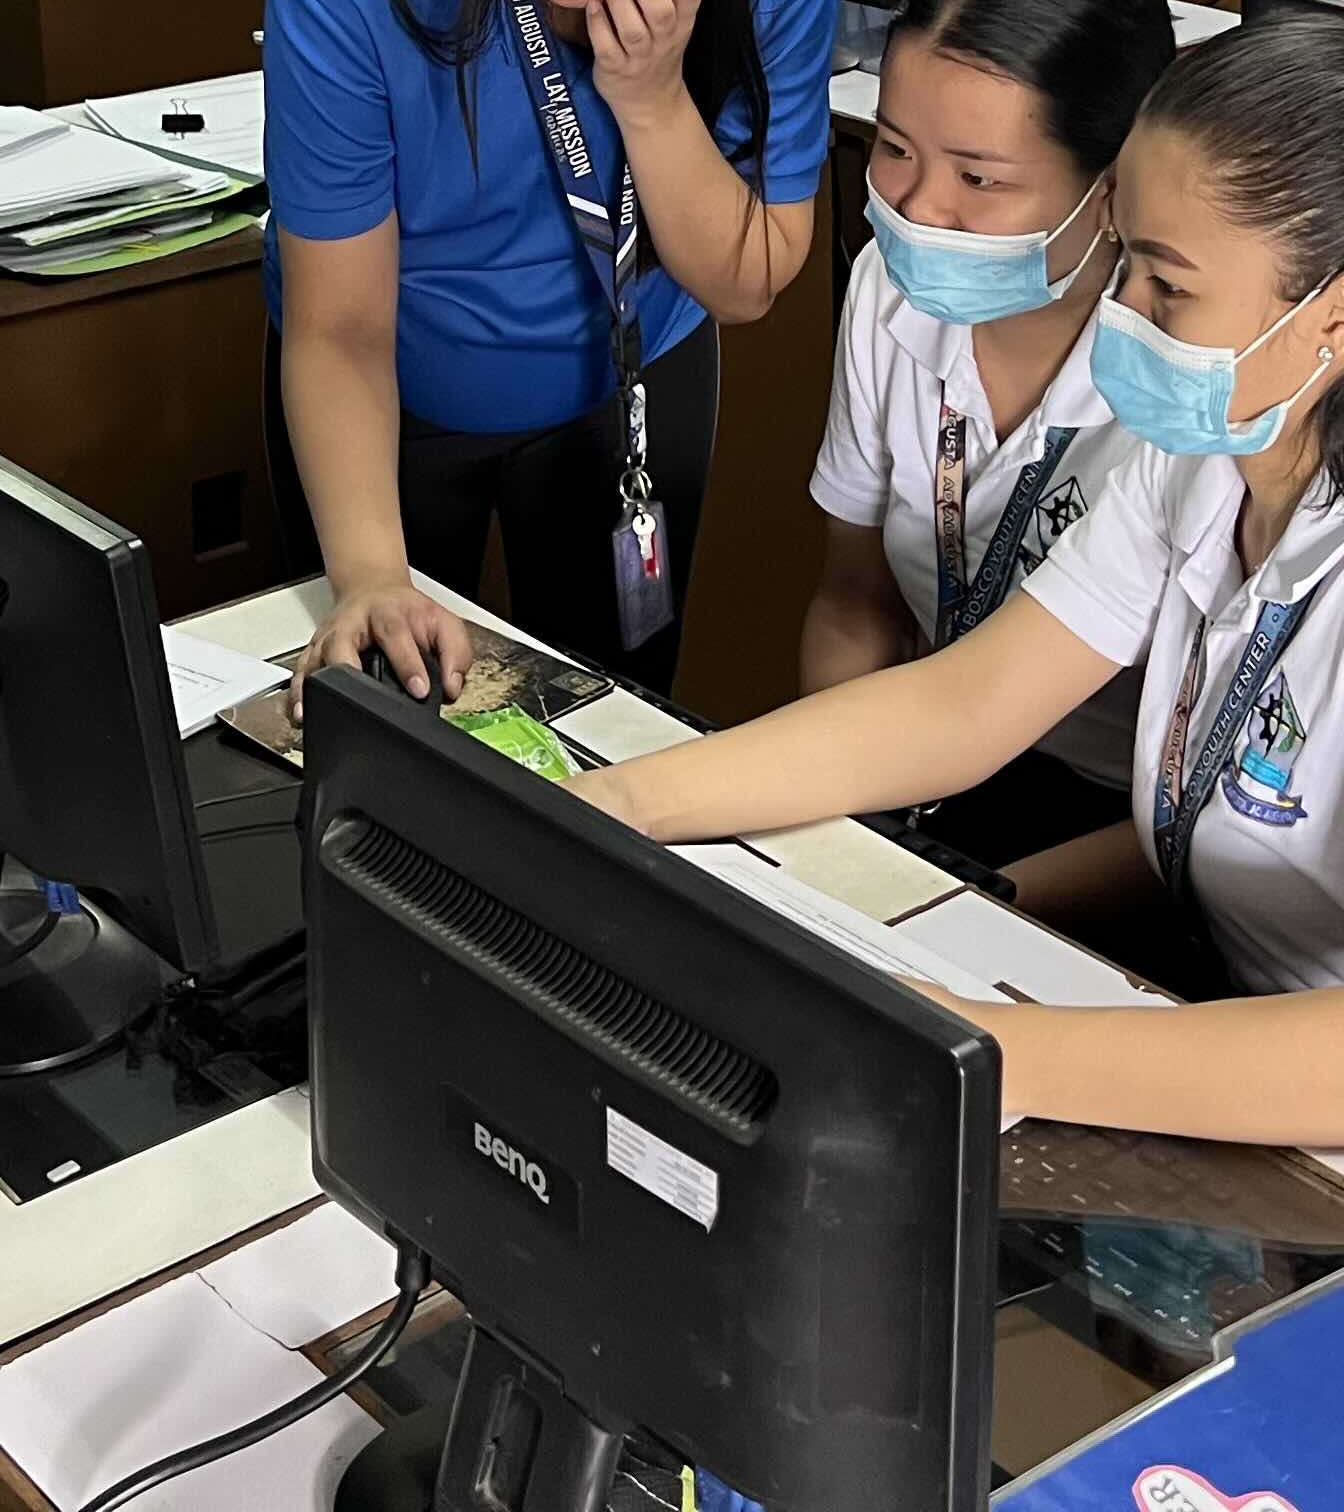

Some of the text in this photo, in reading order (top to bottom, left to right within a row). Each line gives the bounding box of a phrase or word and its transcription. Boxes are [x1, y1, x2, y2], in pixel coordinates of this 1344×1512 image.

[514, 5, 552, 69] AUGUSTA
[543, 73, 593, 179] LAY MISSION
[620, 188, 634, 225] DON
[963, 568, 996, 626] BOSCO
[991, 510, 1020, 565] YOUTH
[1194, 631, 1270, 779] YOUTH CENTER
[475, 1122, 549, 1204] BenQ
